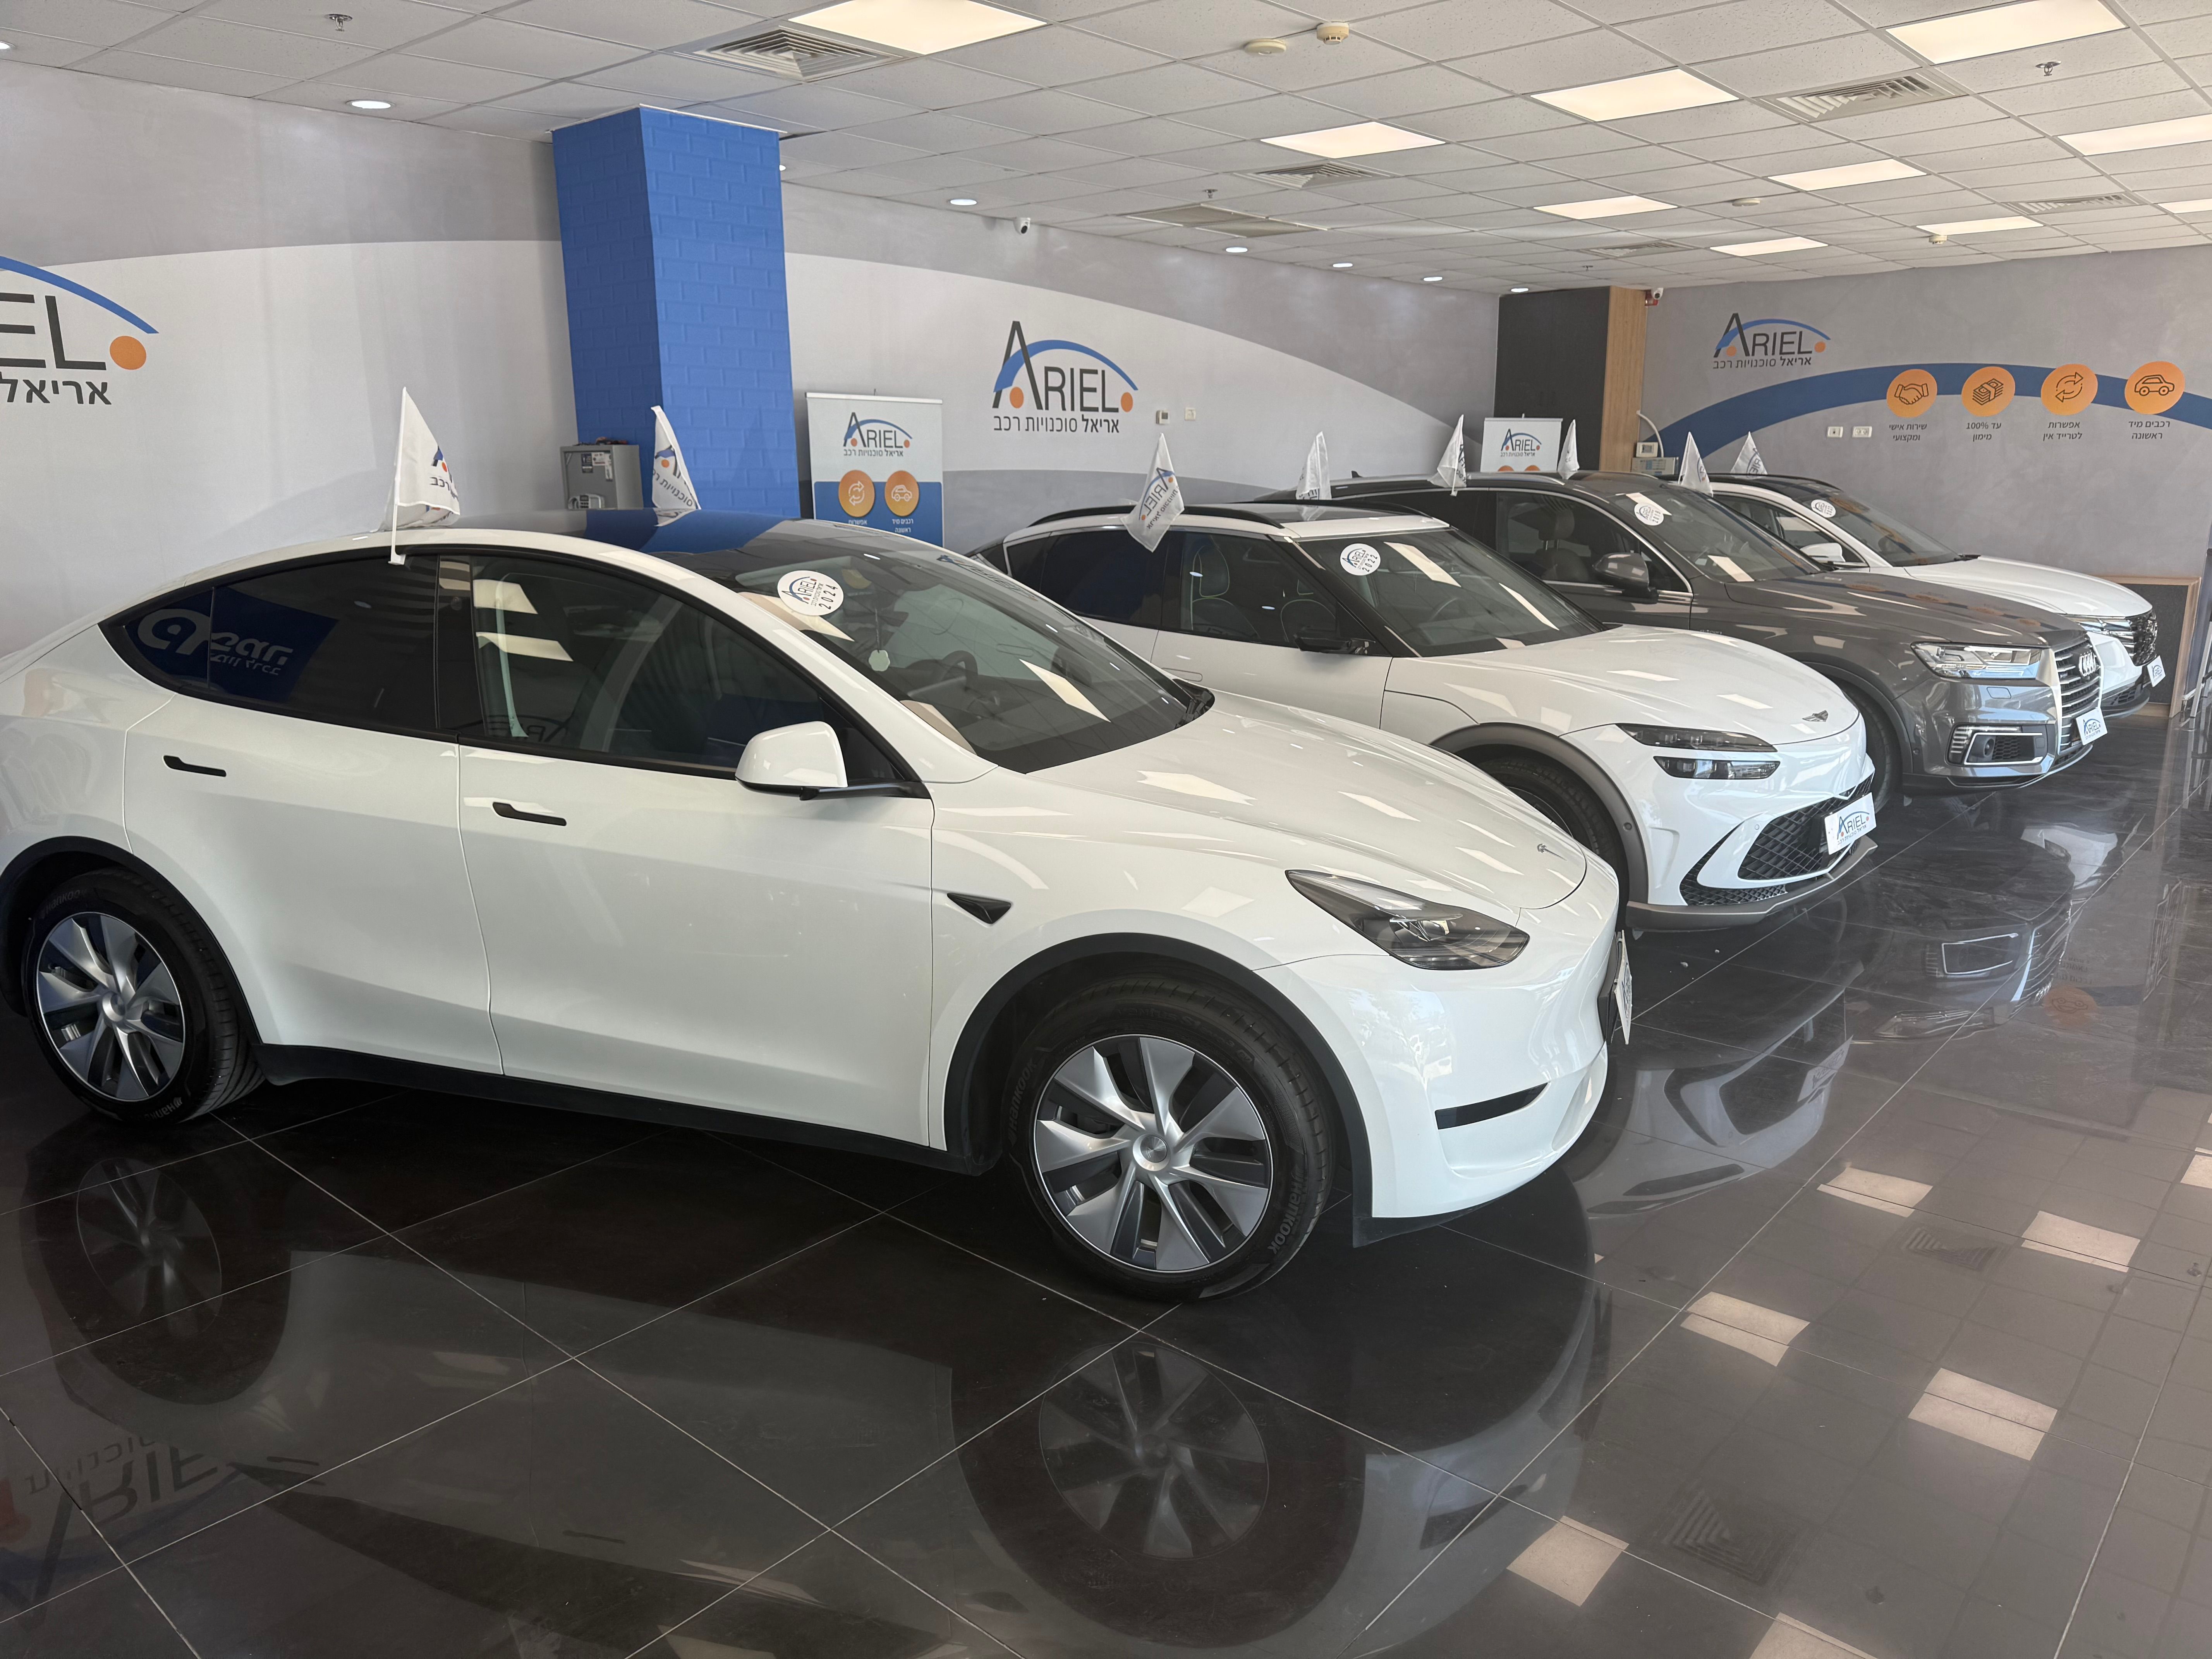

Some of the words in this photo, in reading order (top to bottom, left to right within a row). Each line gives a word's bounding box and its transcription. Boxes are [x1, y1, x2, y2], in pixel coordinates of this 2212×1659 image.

[1714, 313, 1812, 357] ARIEL
[992, 321, 1119, 413] ARIEL
[1713, 360, 1732, 369] רכב
[1735, 359, 1776, 368] סוכנויות
[1780, 356, 1811, 367] אריאל
[0, 371, 112, 405] אריאל
[843, 412, 903, 448] ARIEL
[994, 416, 1020, 431] רכב
[1025, 417, 1077, 433] סוכנויות
[1082, 414, 1119, 433] אריאל
[1501, 429, 1535, 451] ARIEL
[1973, 433, 1992, 442] מימון
[2043, 433, 2054, 441] אין
[660, 478, 693, 507] סוכנויות
[1342, 551, 1365, 568] ARIEL
[1362, 555, 1377, 572] 2022
[781, 580, 816, 604] ARIEL
[819, 584, 838, 610] 2024
[2083, 719, 2100, 736] ARIEL
[1837, 814, 1866, 840] ARIEL
